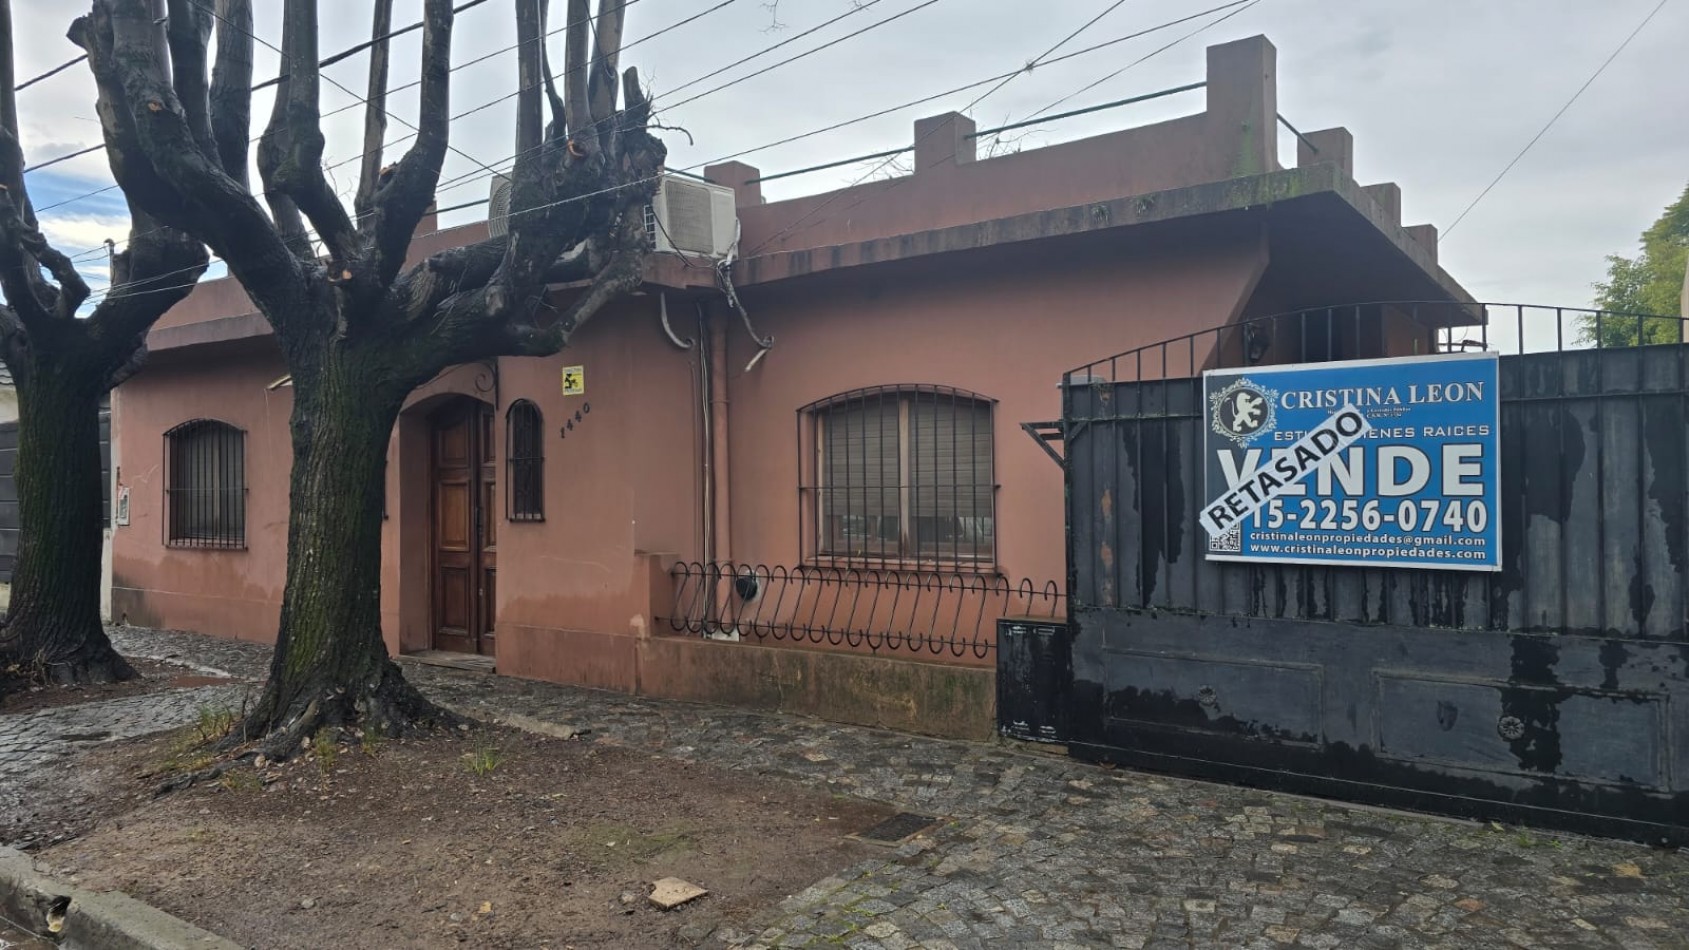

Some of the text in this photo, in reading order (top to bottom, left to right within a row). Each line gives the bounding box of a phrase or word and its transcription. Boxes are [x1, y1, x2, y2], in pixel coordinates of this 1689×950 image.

[1281, 382, 1484, 409] CRISTINA LEON
[1363, 427, 1415, 439] IENES
[1423, 425, 1489, 437] RAICES
[1207, 411, 1363, 530] RETASADO
[1253, 499, 1487, 533] 15-2256-0740
[1250, 531, 1486, 547] cristinaleonpropiedades@gmail.com
[1250, 543, 1486, 560] www.cristinaleonpropiedades.com
